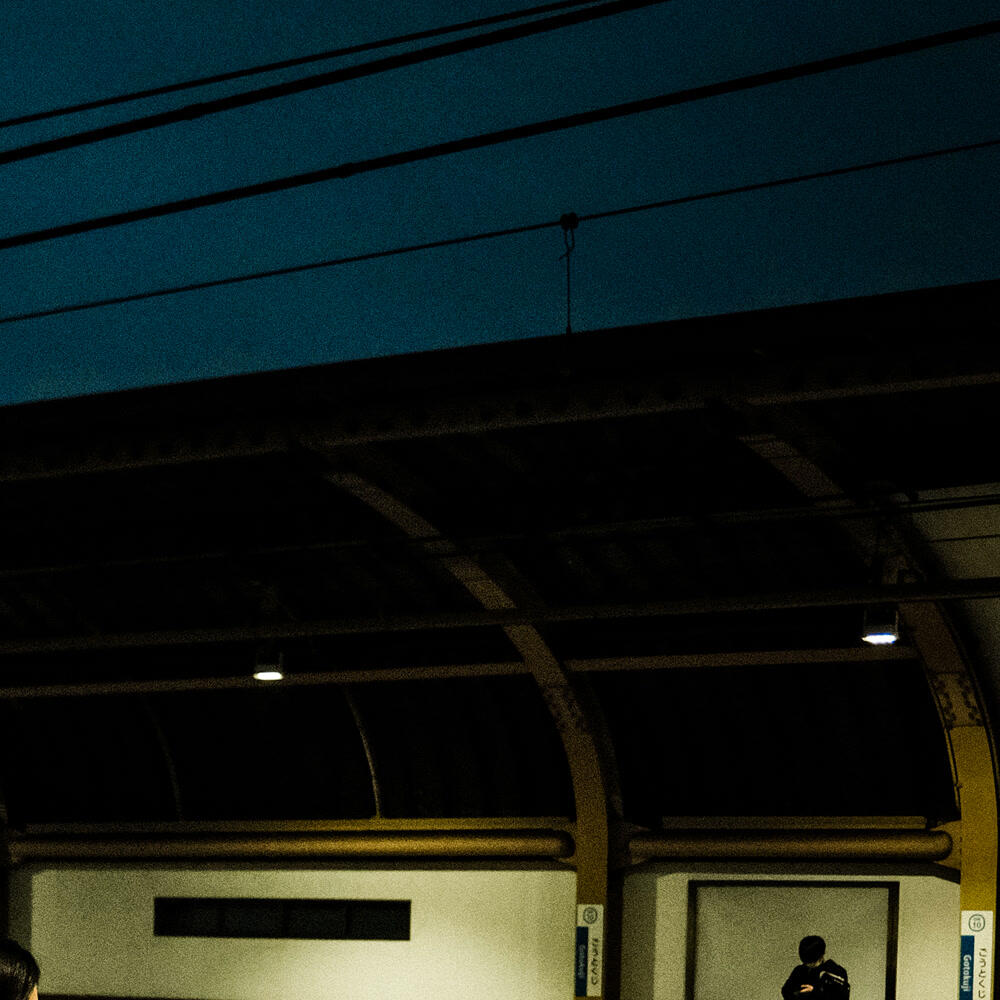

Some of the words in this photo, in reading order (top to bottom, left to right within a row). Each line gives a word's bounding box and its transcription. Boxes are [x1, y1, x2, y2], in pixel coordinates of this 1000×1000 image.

[961, 954, 972, 992] Gotokuji
[978, 948, 987, 999] ごうとくじ
